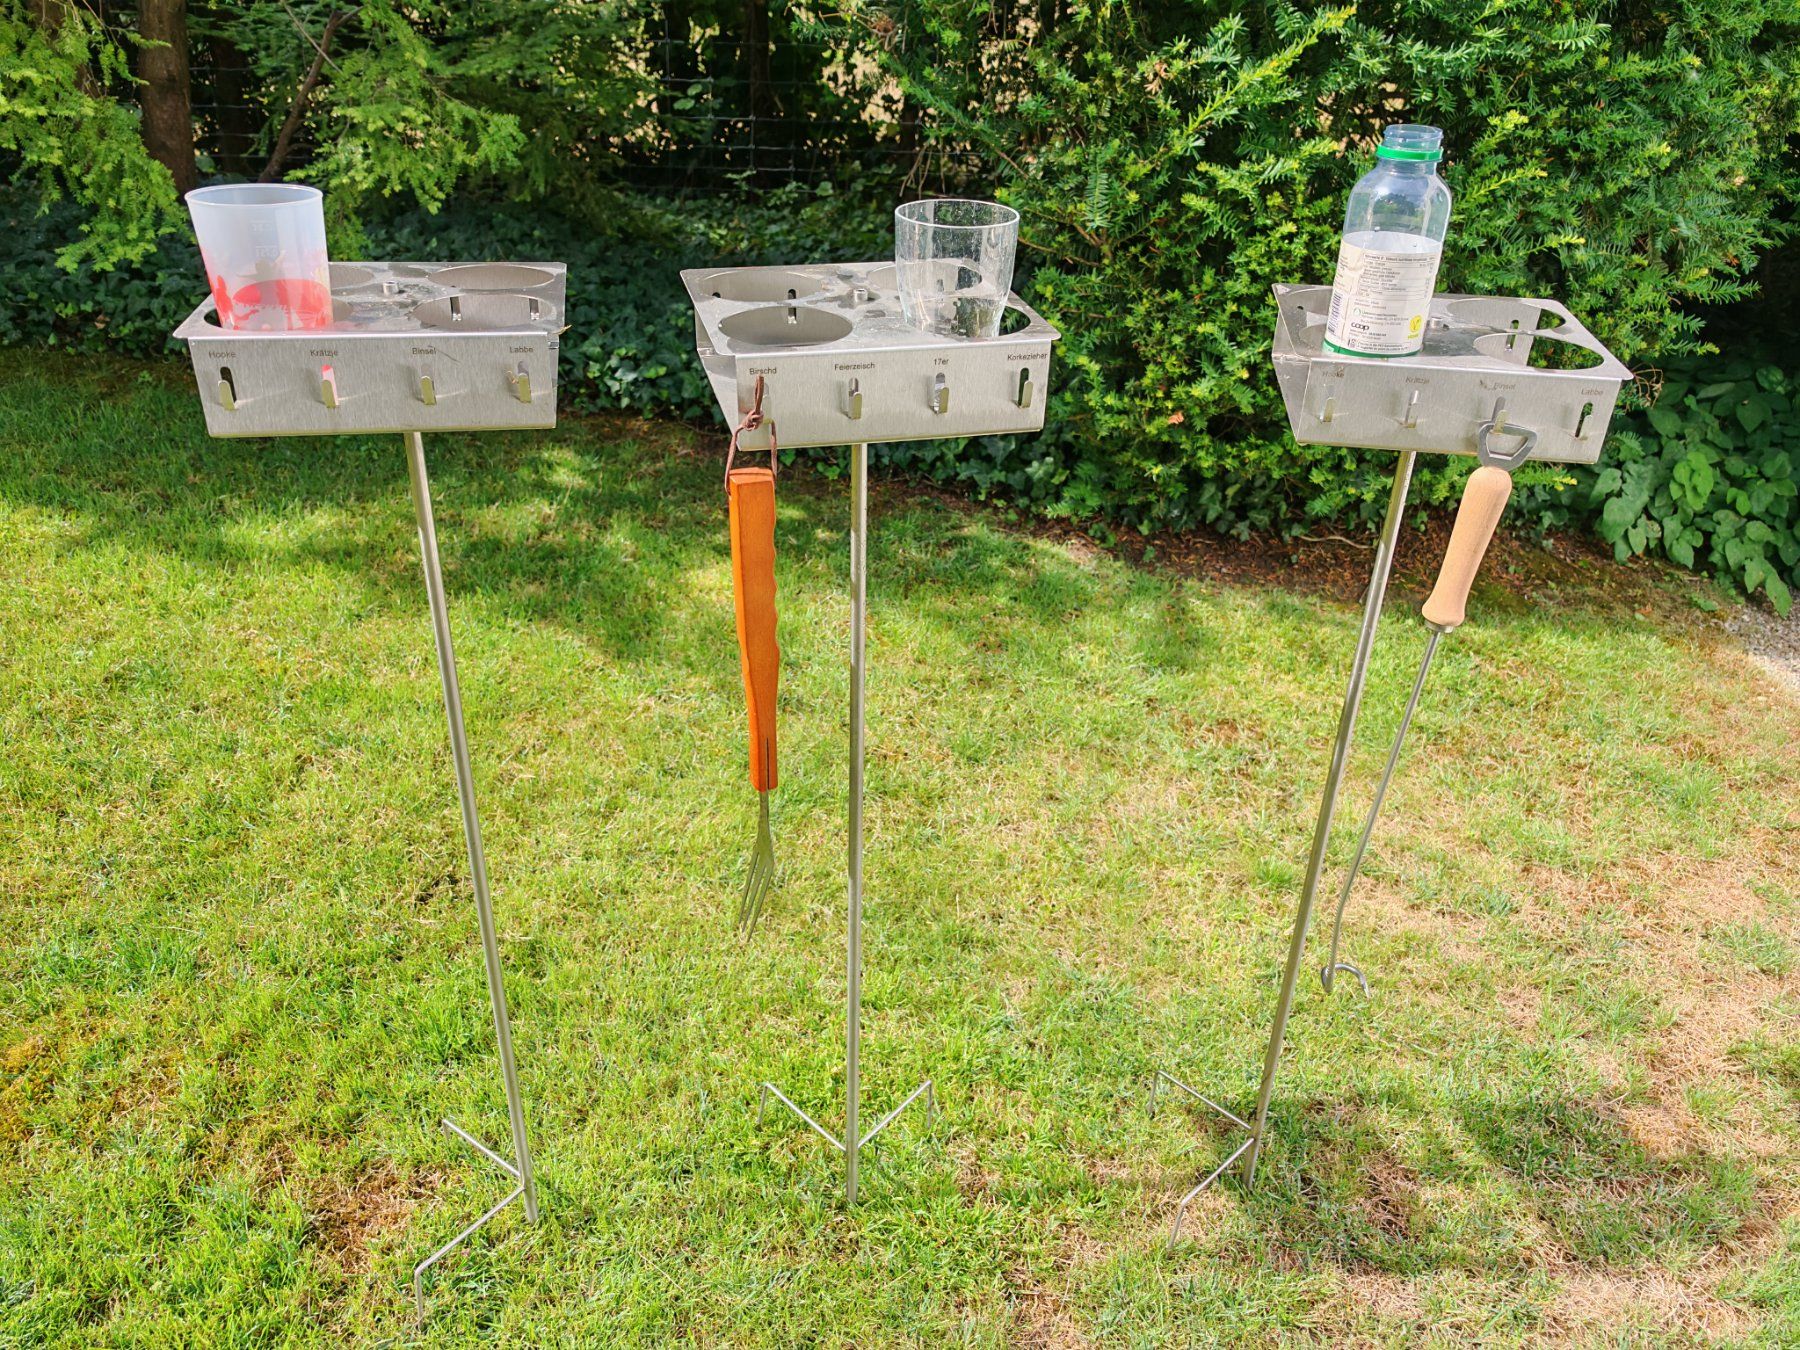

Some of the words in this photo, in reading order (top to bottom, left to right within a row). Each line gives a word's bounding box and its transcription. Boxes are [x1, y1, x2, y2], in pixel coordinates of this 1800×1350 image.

[1351, 321, 1370, 332] coop
[412, 347, 437, 355] Binsel
[509, 346, 535, 354] Labbe
[933, 357, 949, 366] 17er
[1007, 352, 1048, 362] Korkezieher
[749, 366, 778, 376] Birschd
[834, 361, 876, 371] Feierzeisch
